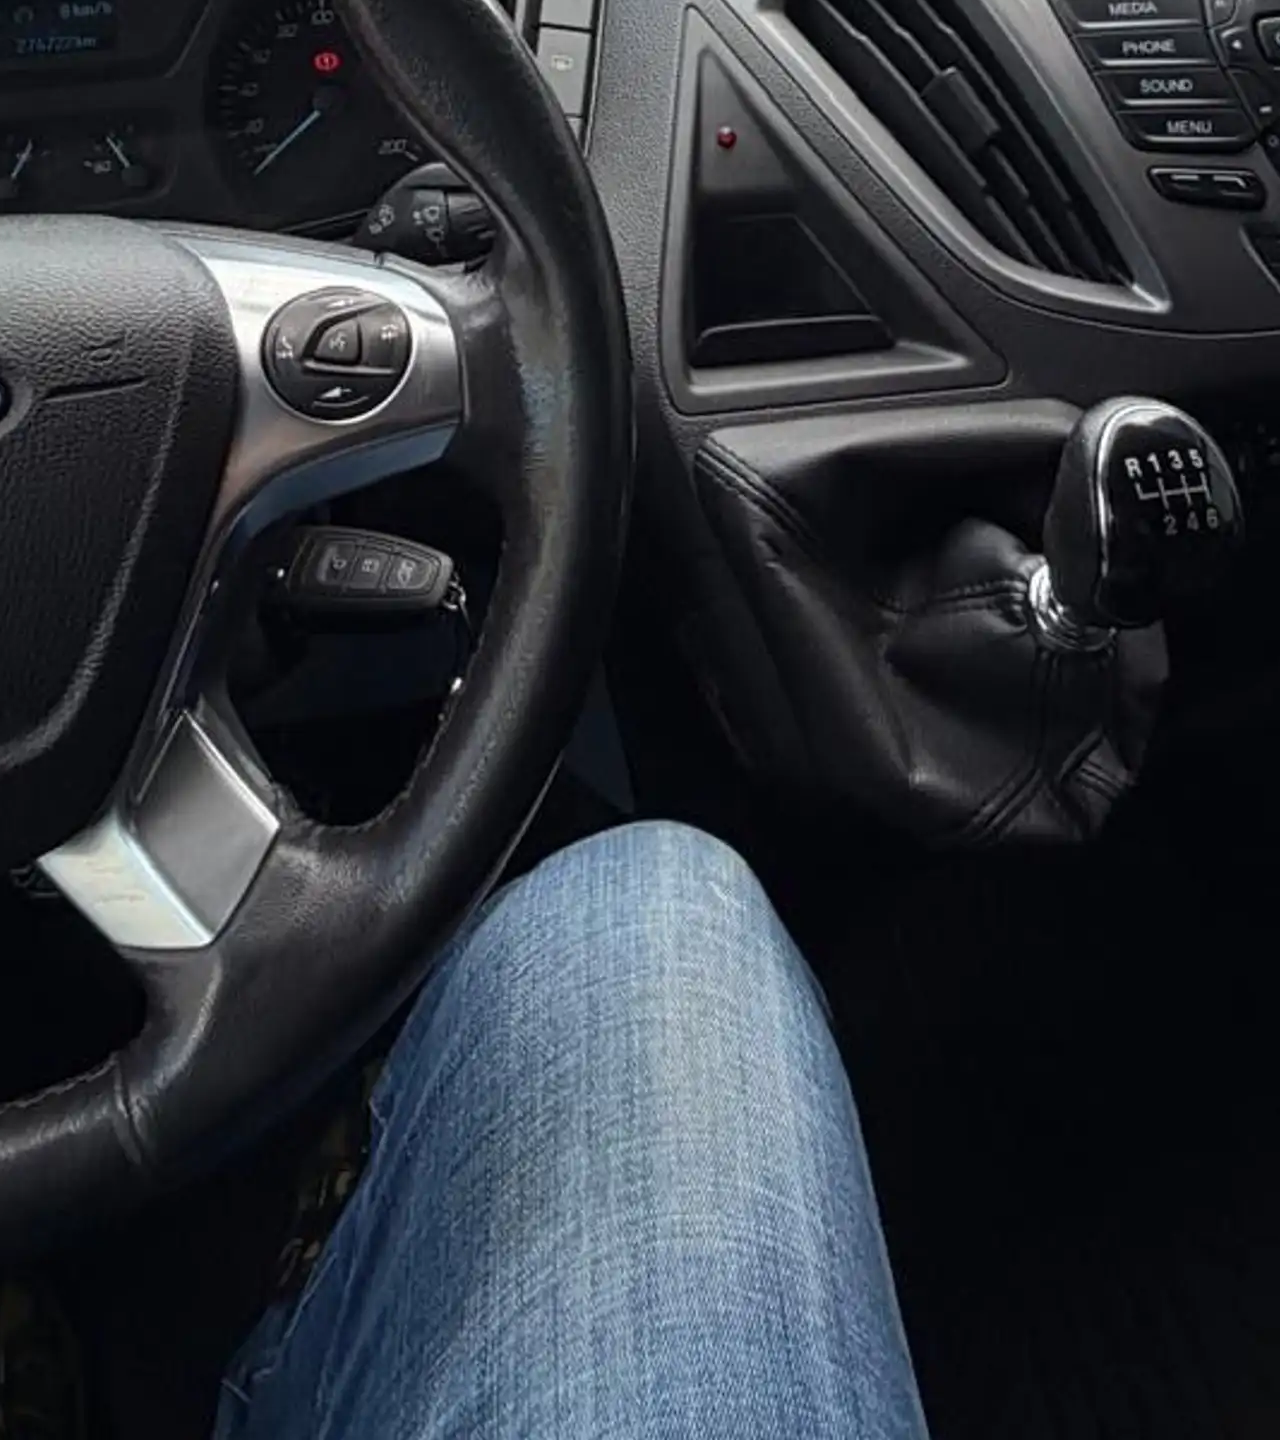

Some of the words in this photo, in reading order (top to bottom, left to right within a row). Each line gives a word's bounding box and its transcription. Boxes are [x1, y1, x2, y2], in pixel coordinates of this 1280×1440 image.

[1108, 1, 1158, 16] MEDIA
[1121, 39, 1177, 56] PHONE
[1139, 78, 1194, 95] SOUND
[1165, 120, 1213, 134] MENU
[1124, 457, 1143, 479] R
[1147, 452, 1161, 473] 1
[1167, 449, 1184, 470] 3
[1188, 448, 1204, 469] 5
[1163, 514, 1178, 536] 2
[1187, 511, 1199, 531] 4
[1206, 508, 1219, 529] 6
